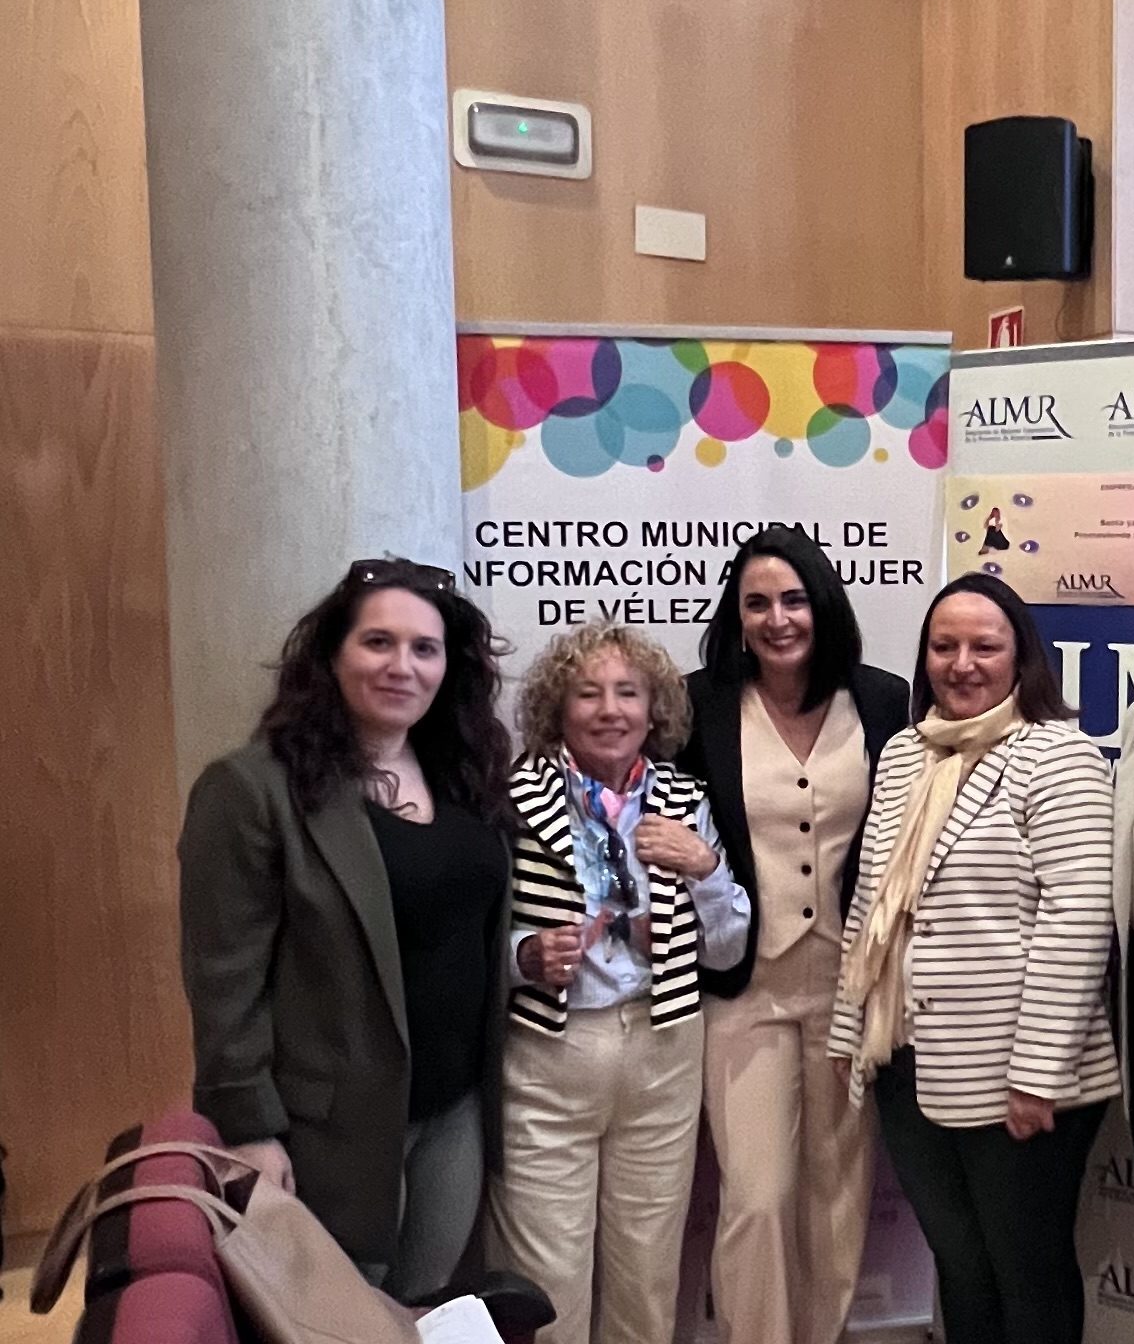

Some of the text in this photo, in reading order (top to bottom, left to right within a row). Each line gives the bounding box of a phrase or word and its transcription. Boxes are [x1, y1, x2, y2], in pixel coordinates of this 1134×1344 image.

[958, 394, 1074, 439] ALMUR
[475, 521, 889, 548] CENTRO MUNICL DE
[463, 553, 706, 587] NFORMACIÓN
[834, 559, 925, 586] UJER
[1055, 573, 1126, 599] ALMUR
[538, 591, 713, 626] DE VÉLEZ
